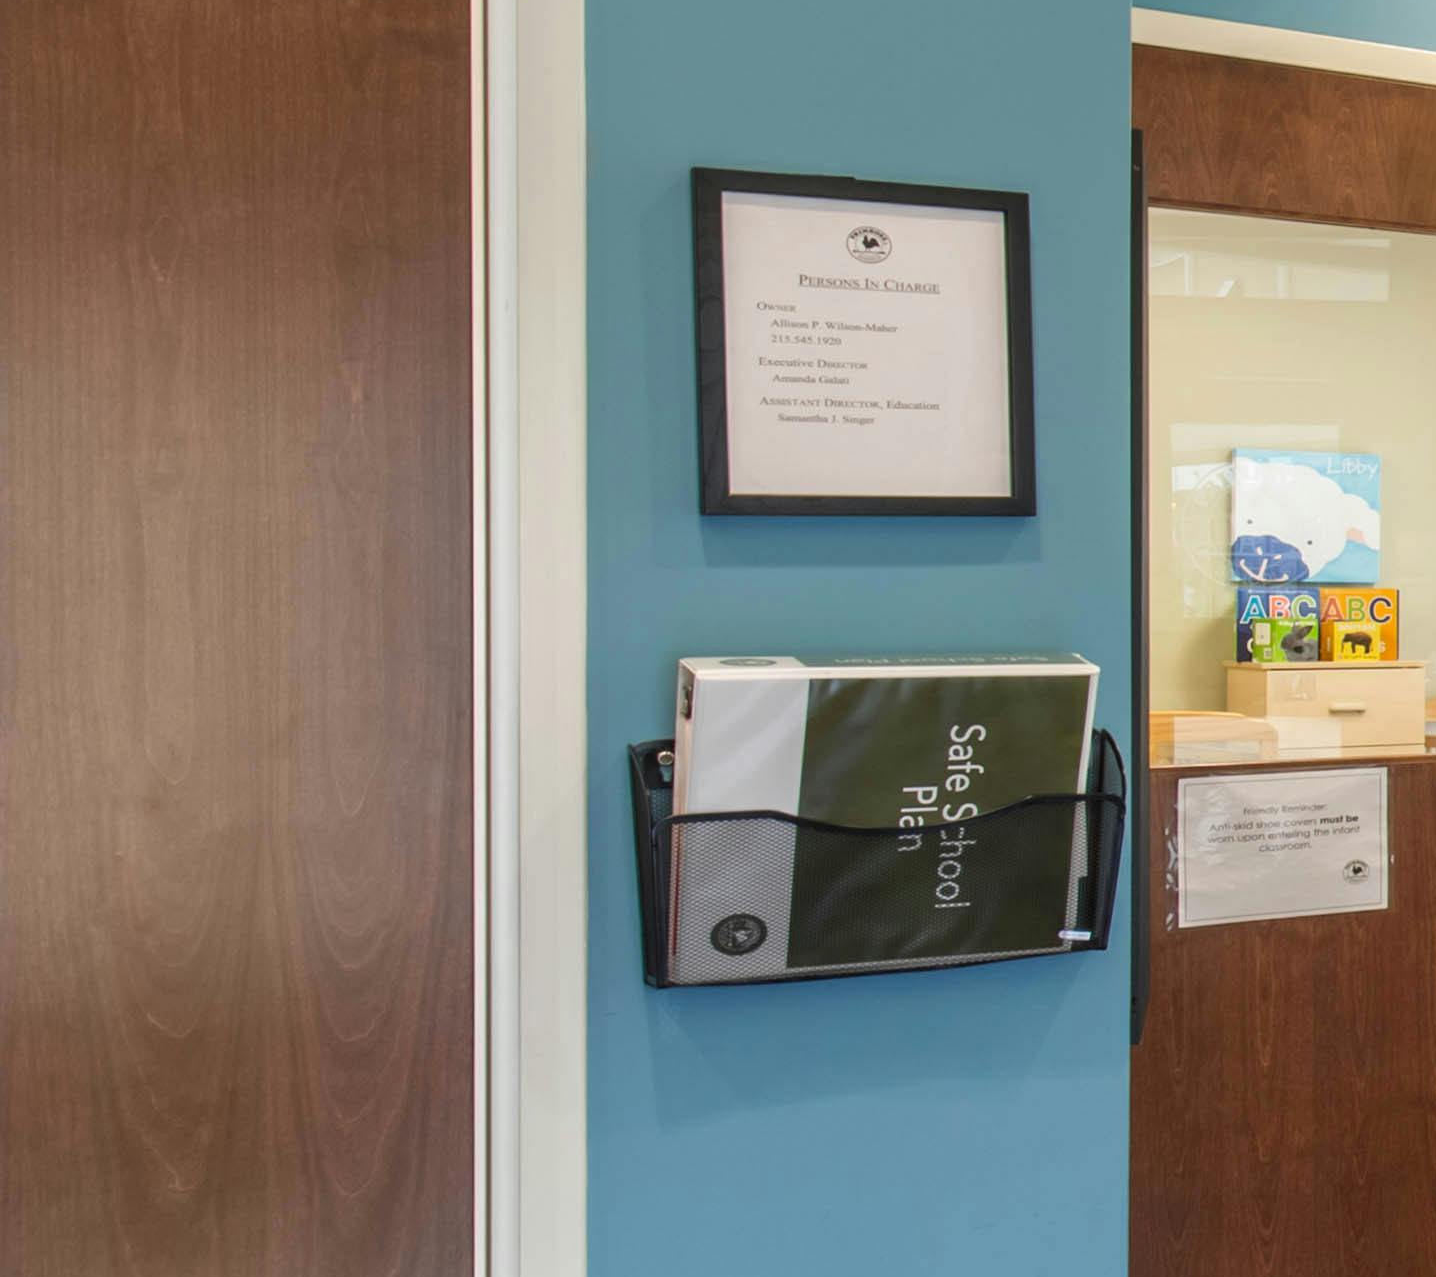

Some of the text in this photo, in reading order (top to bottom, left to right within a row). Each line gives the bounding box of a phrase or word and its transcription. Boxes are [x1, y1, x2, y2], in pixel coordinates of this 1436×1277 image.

[799, 274, 861, 290] PERSONS
[884, 279, 941, 294] CHARGE
[770, 319, 809, 329] Allison
[758, 357, 814, 368] Executive
[772, 374, 816, 384] Amanda
[887, 400, 940, 411] Education
[777, 413, 828, 424] Samantha
[1326, 456, 1378, 481] Libby
[1239, 594, 1317, 625] ABC
[1321, 596, 1392, 624] ABC
[945, 724, 987, 793] Safe
[898, 786, 939, 852] Plan
[1242, 806, 1280, 816] Friendly
[1209, 814, 1359, 832] Anti-skid shoe covers must be
[1207, 825, 1360, 844] worn upon entering the infant
